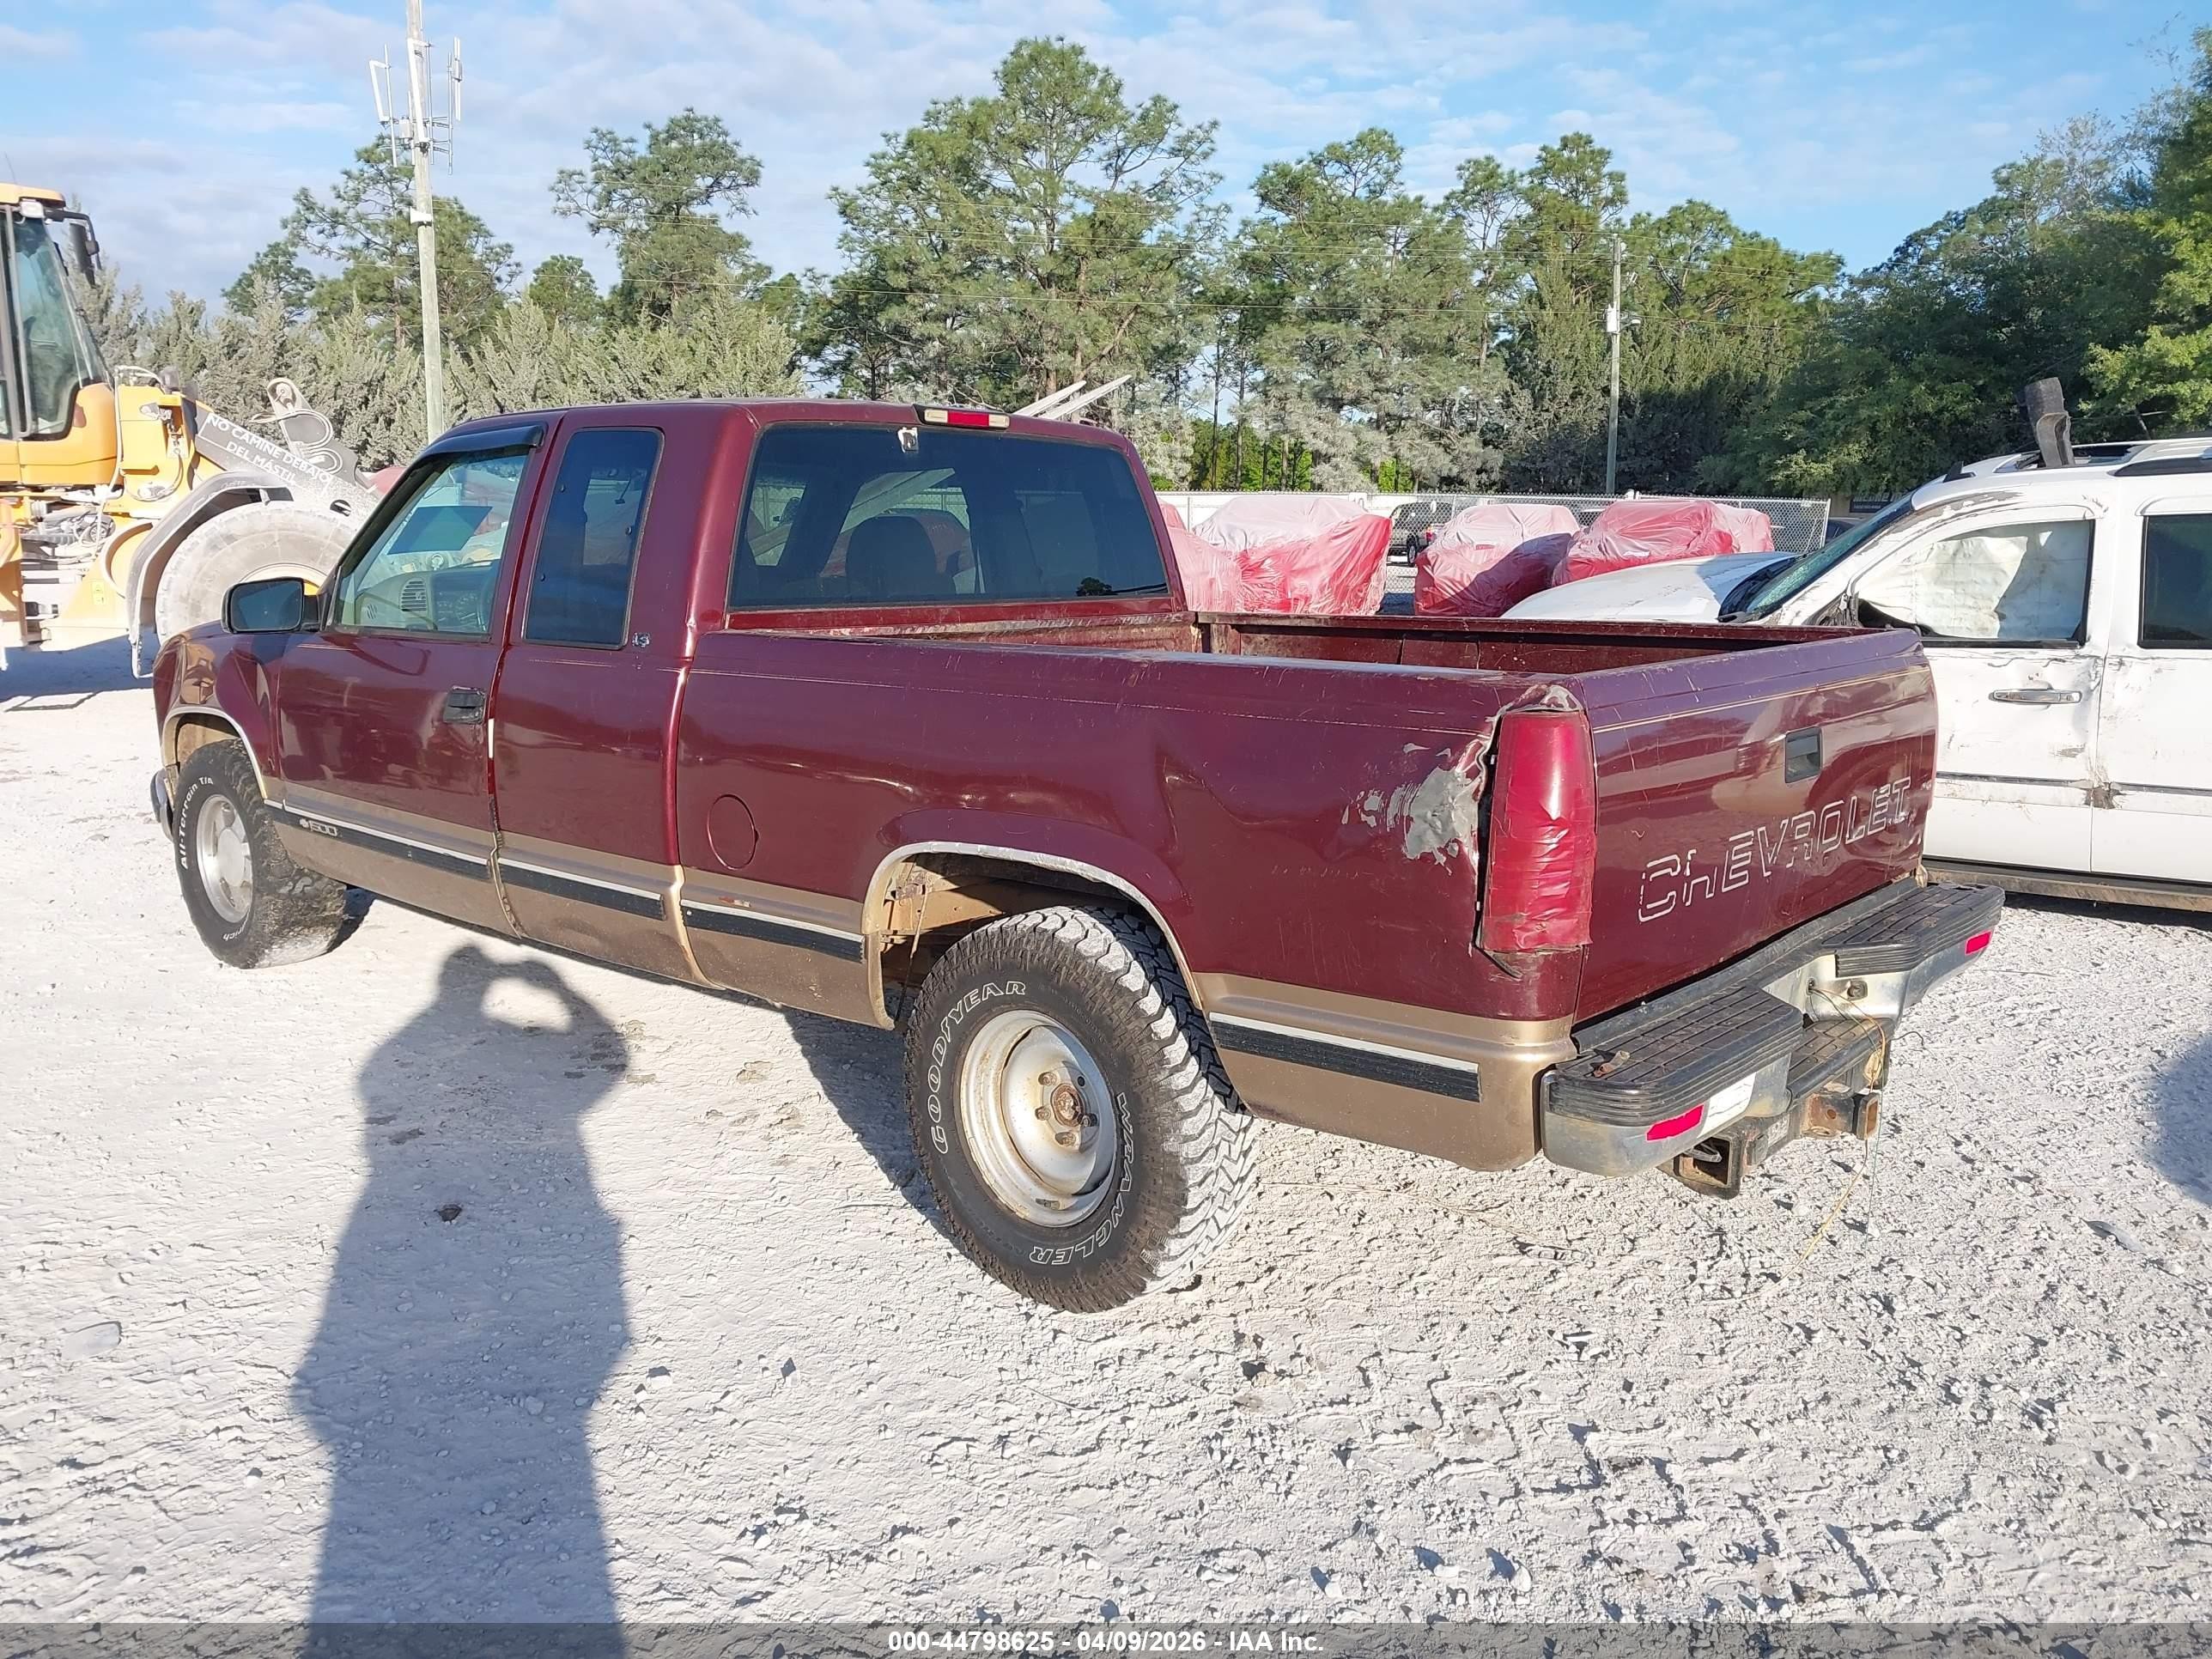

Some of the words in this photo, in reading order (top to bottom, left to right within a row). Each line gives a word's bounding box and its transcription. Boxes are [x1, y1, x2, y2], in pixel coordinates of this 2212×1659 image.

[206, 416, 229, 431] NO
[232, 427, 282, 459] CAMINE
[282, 449, 331, 483] DEBAJO
[226, 441, 252, 460] DEL
[179, 783, 198, 870] All-Terrain
[198, 776, 214, 785] T/A
[1638, 776, 1912, 923] CHEVROLET
[927, 981, 1026, 1154] GOODYEAR
[1029, 1091, 1134, 1266] WRANGLER
